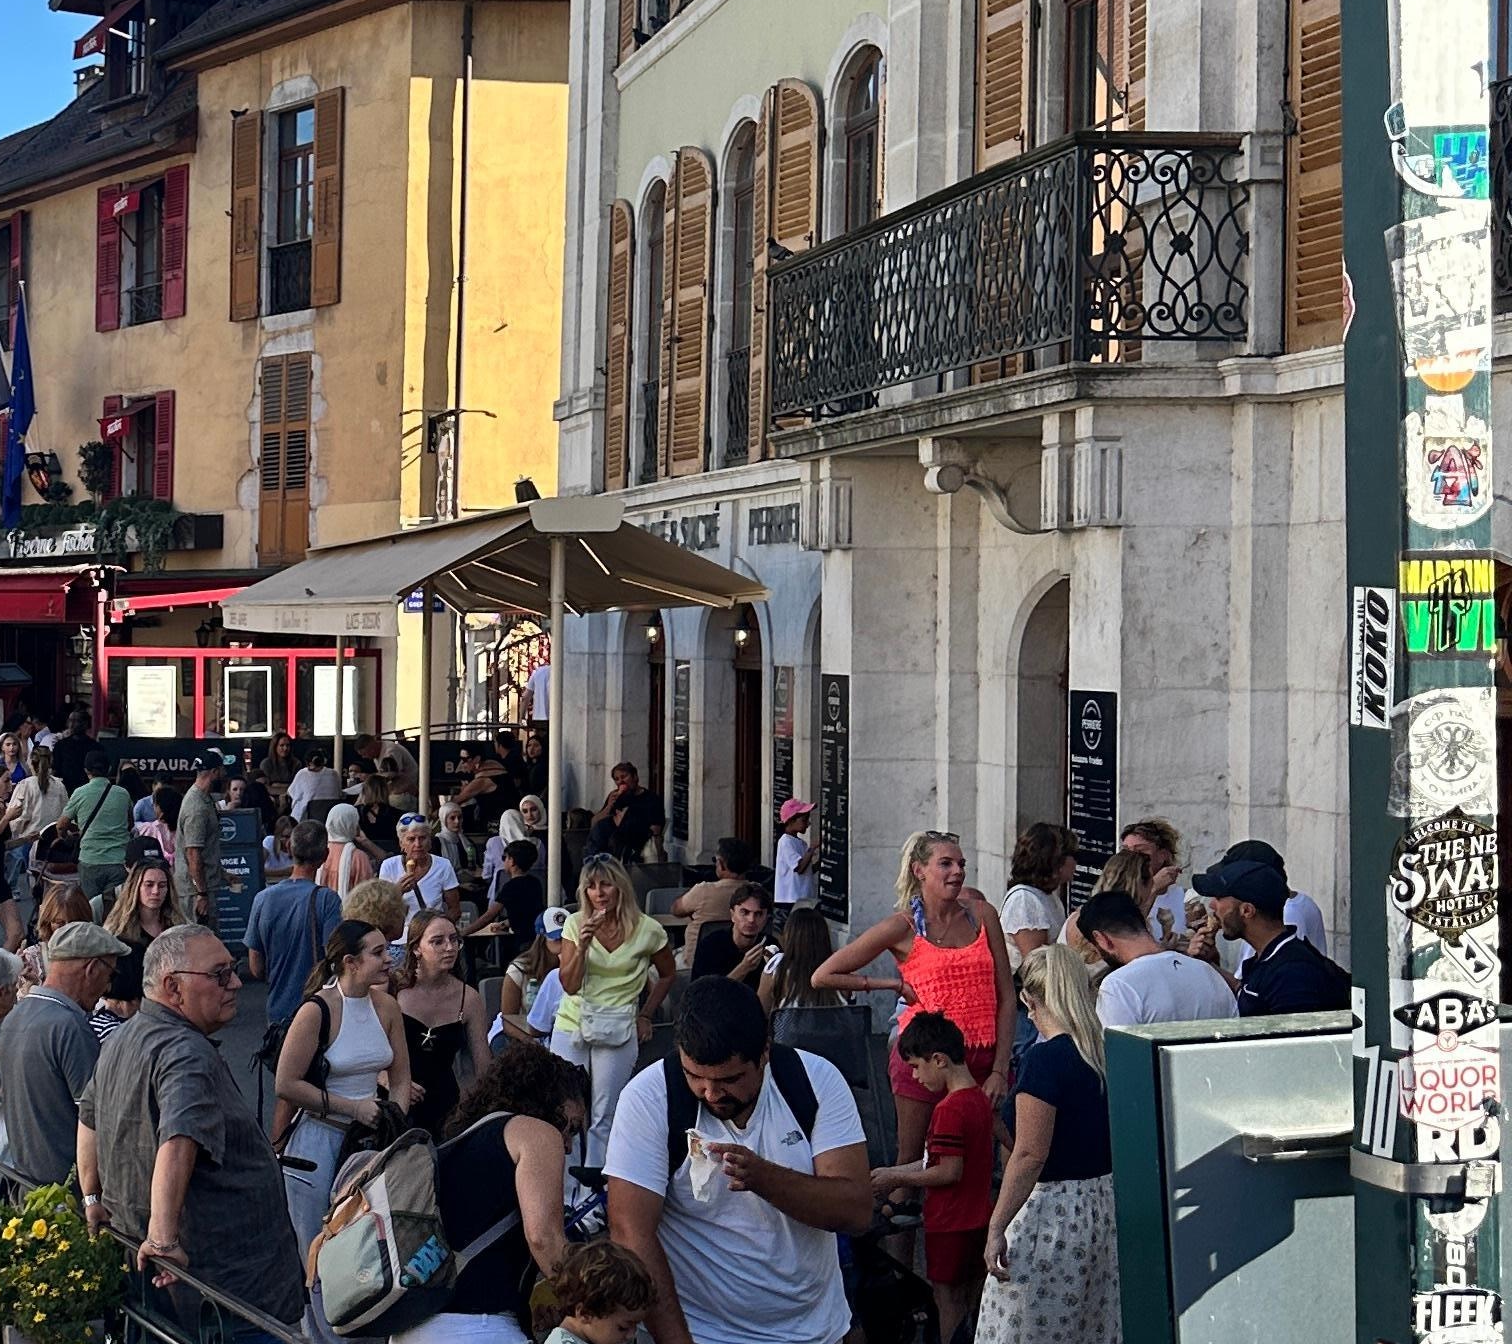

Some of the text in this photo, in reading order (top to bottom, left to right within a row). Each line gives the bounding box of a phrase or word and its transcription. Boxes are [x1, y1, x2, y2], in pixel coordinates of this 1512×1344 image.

[1364, 588, 1389, 723] KOKO
[1405, 819, 1476, 846] WELCOME TO
[1418, 837, 1465, 865] THE
[1436, 894, 1483, 913] HOTEL
[1400, 1064, 1497, 1093] LIQUOR
